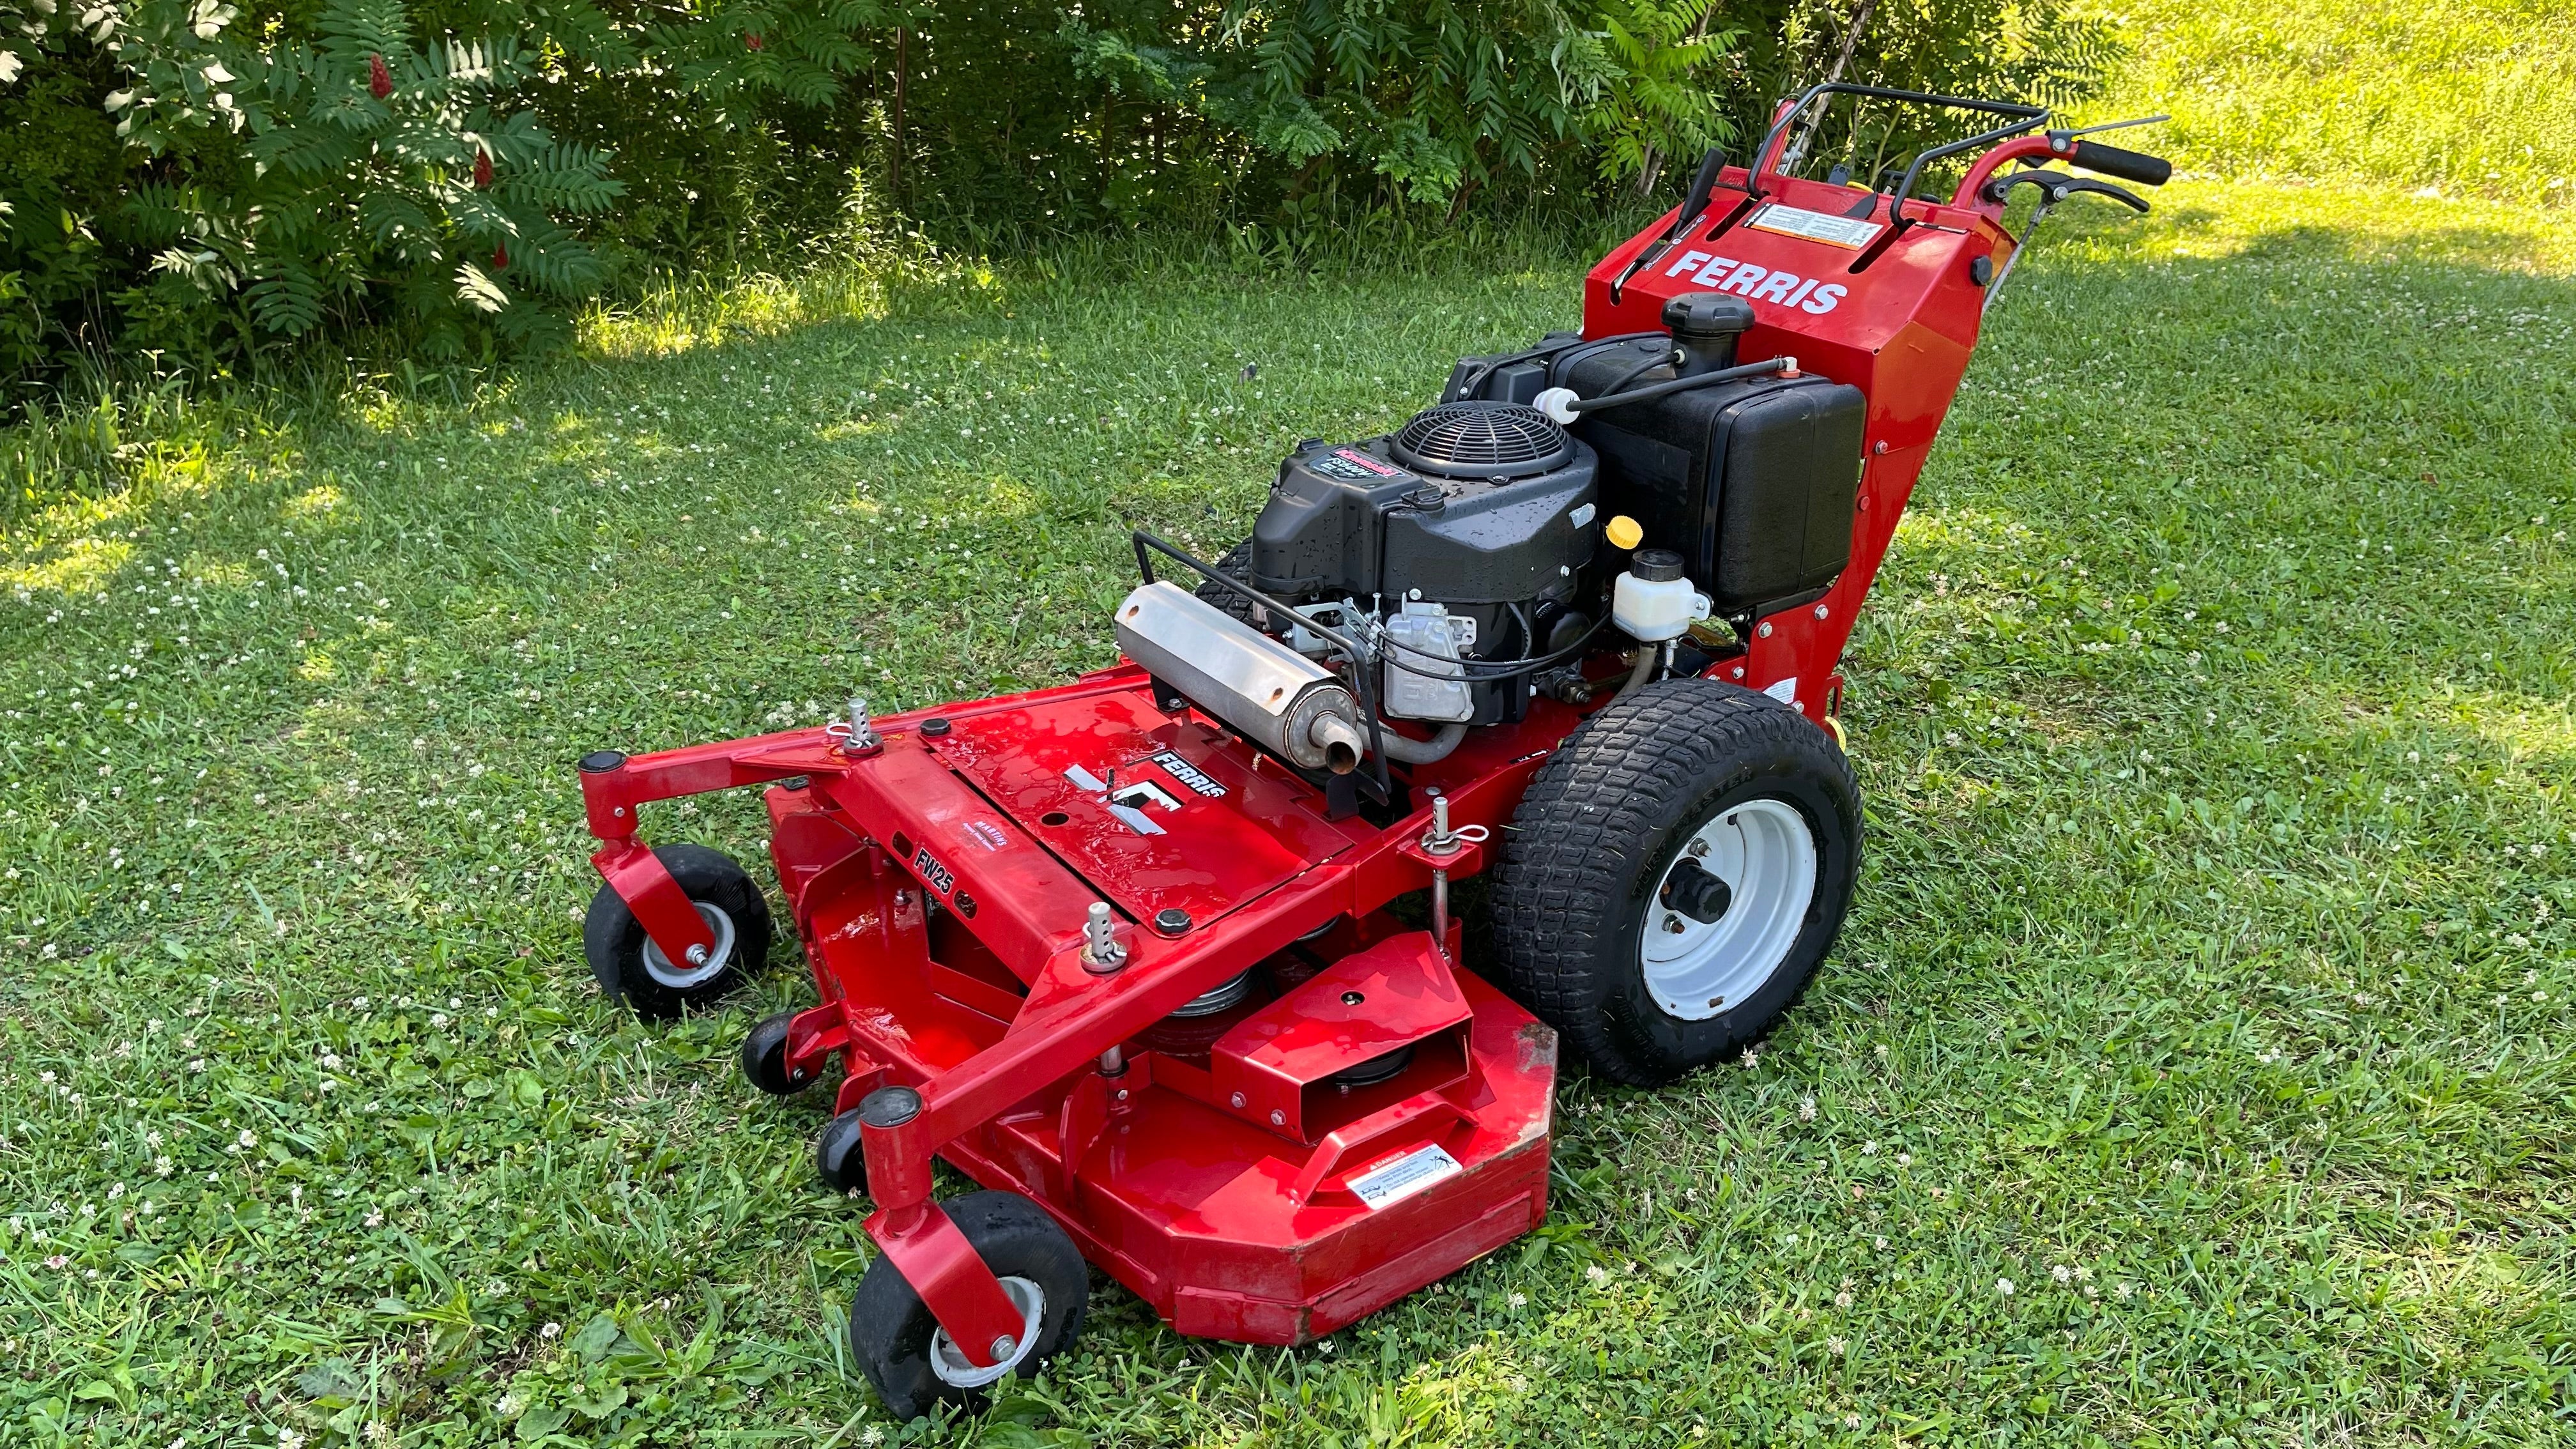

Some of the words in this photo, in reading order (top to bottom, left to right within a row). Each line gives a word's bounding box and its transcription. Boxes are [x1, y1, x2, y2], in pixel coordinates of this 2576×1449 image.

[1664, 250, 1848, 314] FERRIS
[1153, 753, 1226, 798] FERRIS
[914, 847, 955, 894] FW25
[1376, 1151, 1406, 1167] DANGER
